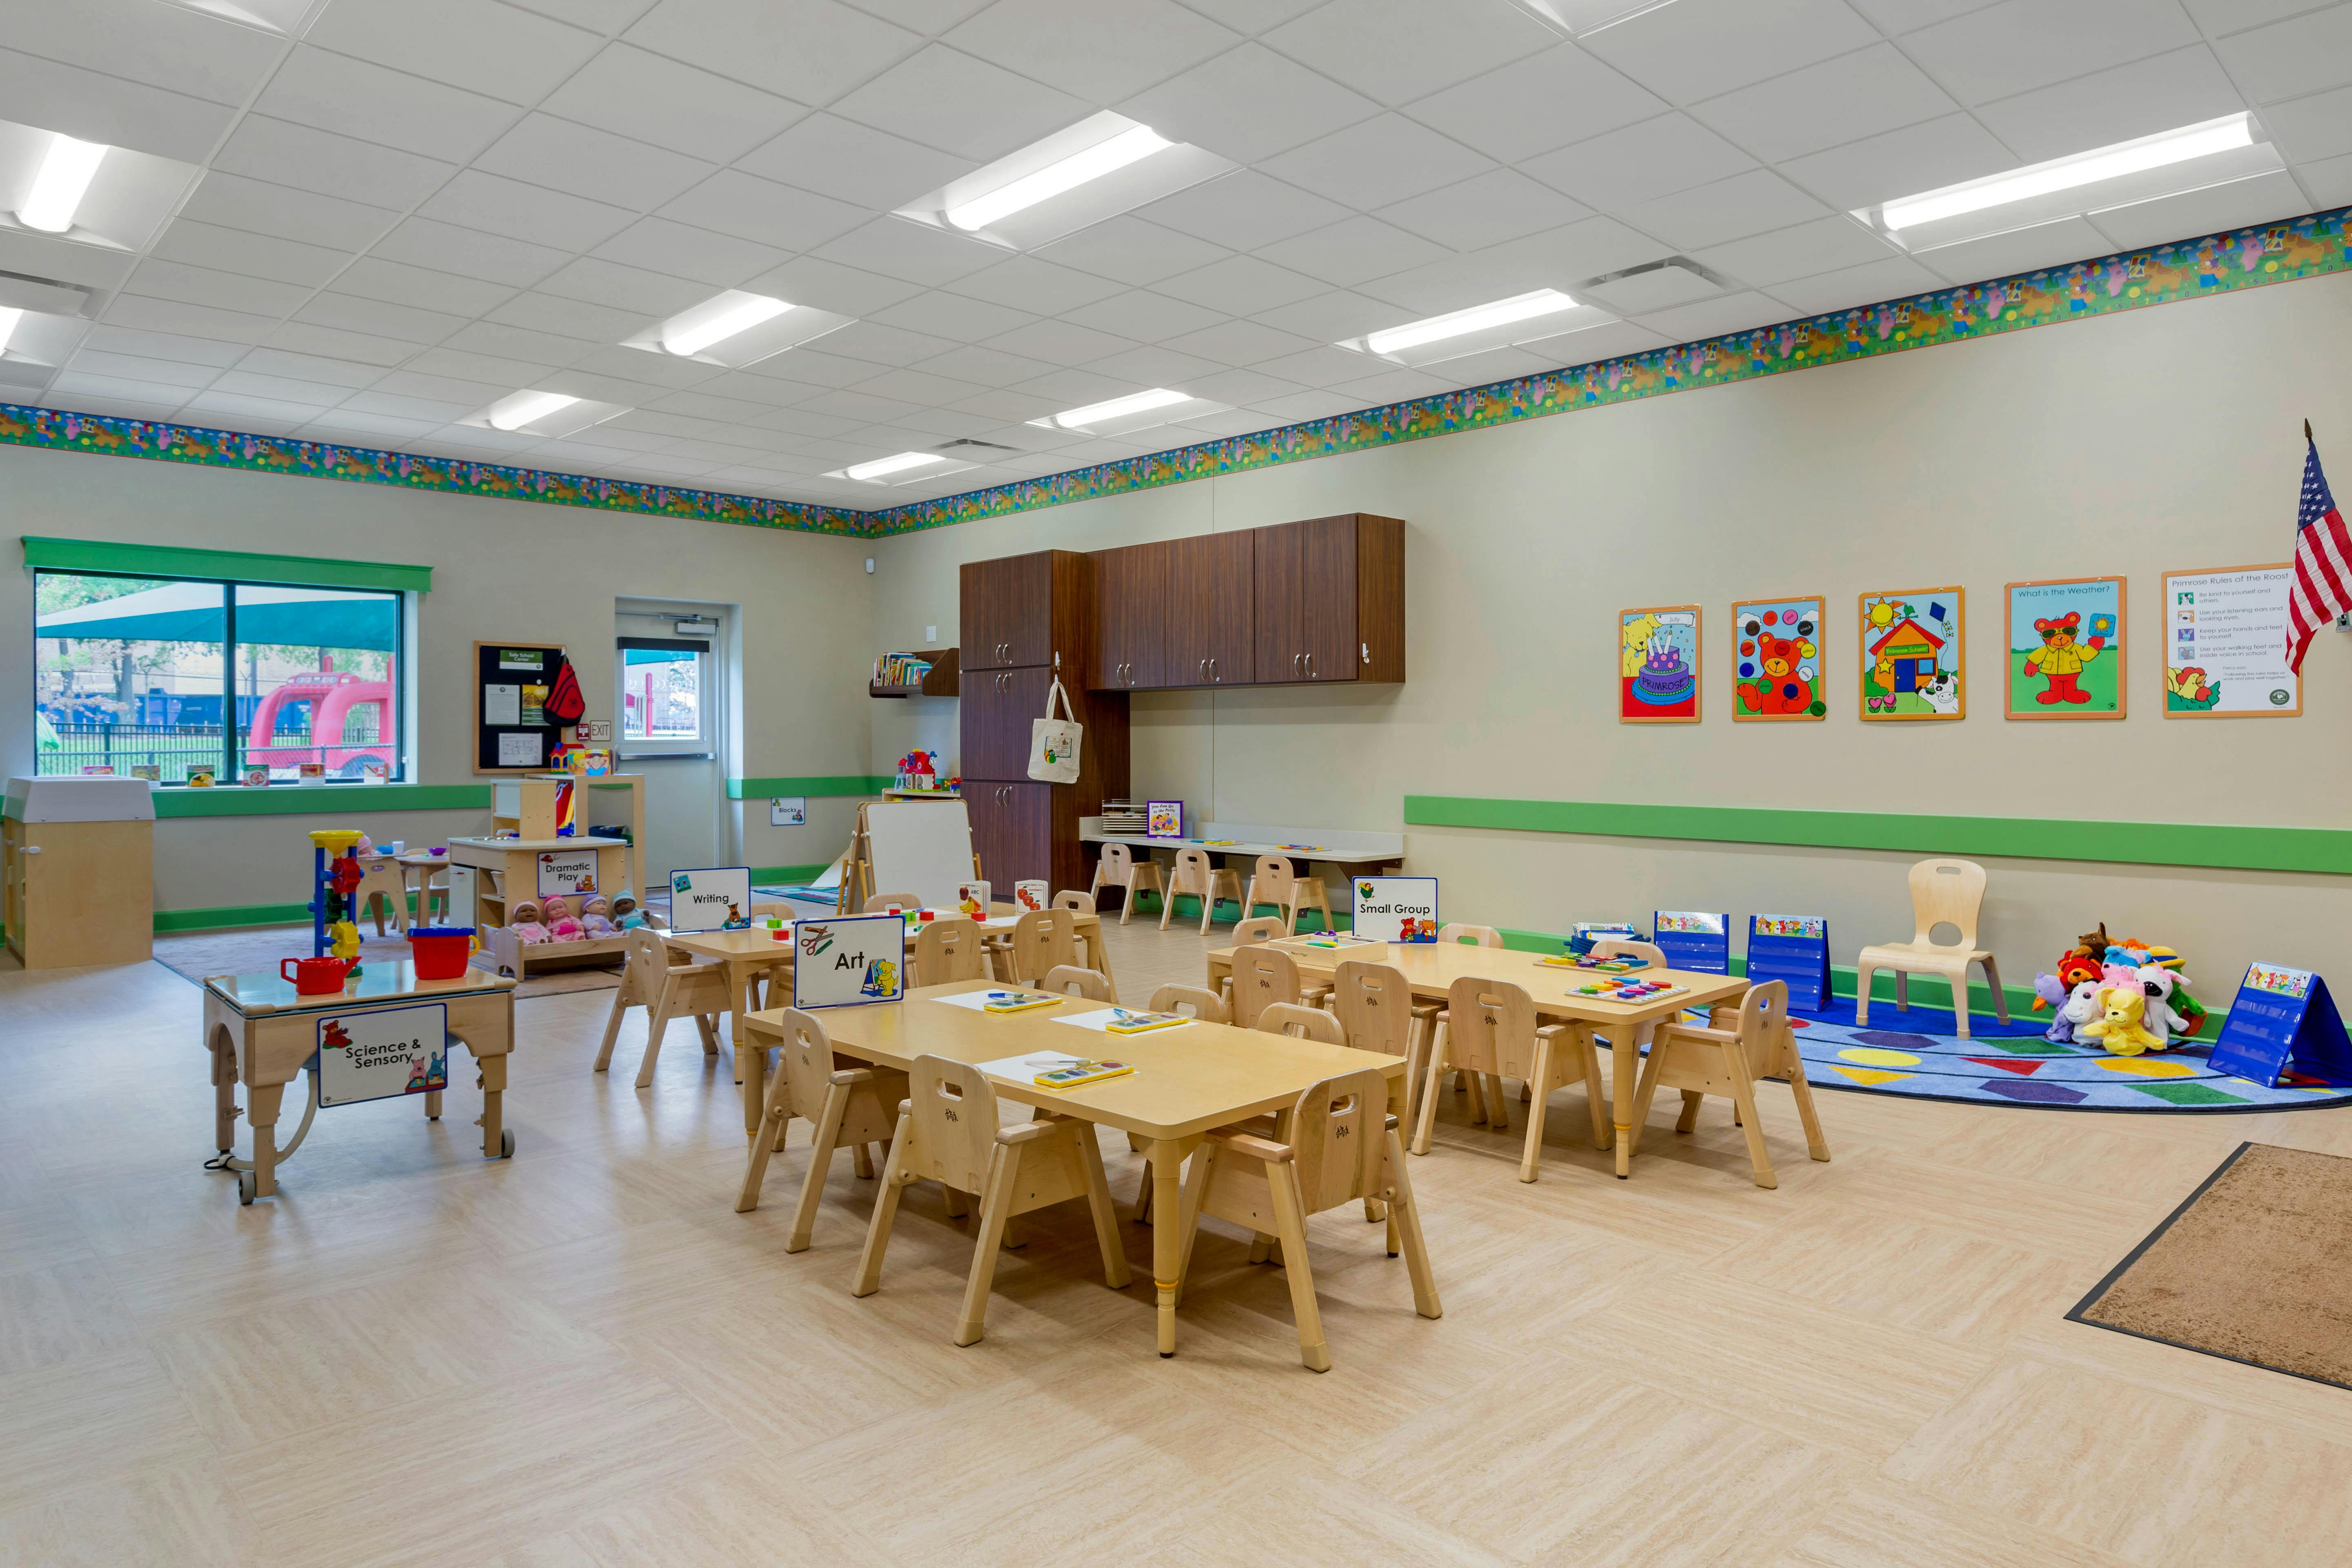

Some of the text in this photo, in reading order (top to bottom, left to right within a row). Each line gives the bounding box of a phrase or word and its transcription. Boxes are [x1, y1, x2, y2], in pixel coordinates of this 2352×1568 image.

[2067, 586, 2110, 594] Weather?
[1642, 676, 1685, 691] PRIMROSE
[592, 724, 609, 736] EXIT
[546, 862, 590, 873] Dramatic
[558, 873, 578, 882] Play
[693, 894, 729, 904] Writing
[1360, 904, 1430, 916] Small Group
[834, 951, 864, 970] Art
[346, 1039, 421, 1058] Science &
[355, 1053, 413, 1069] Sensory
